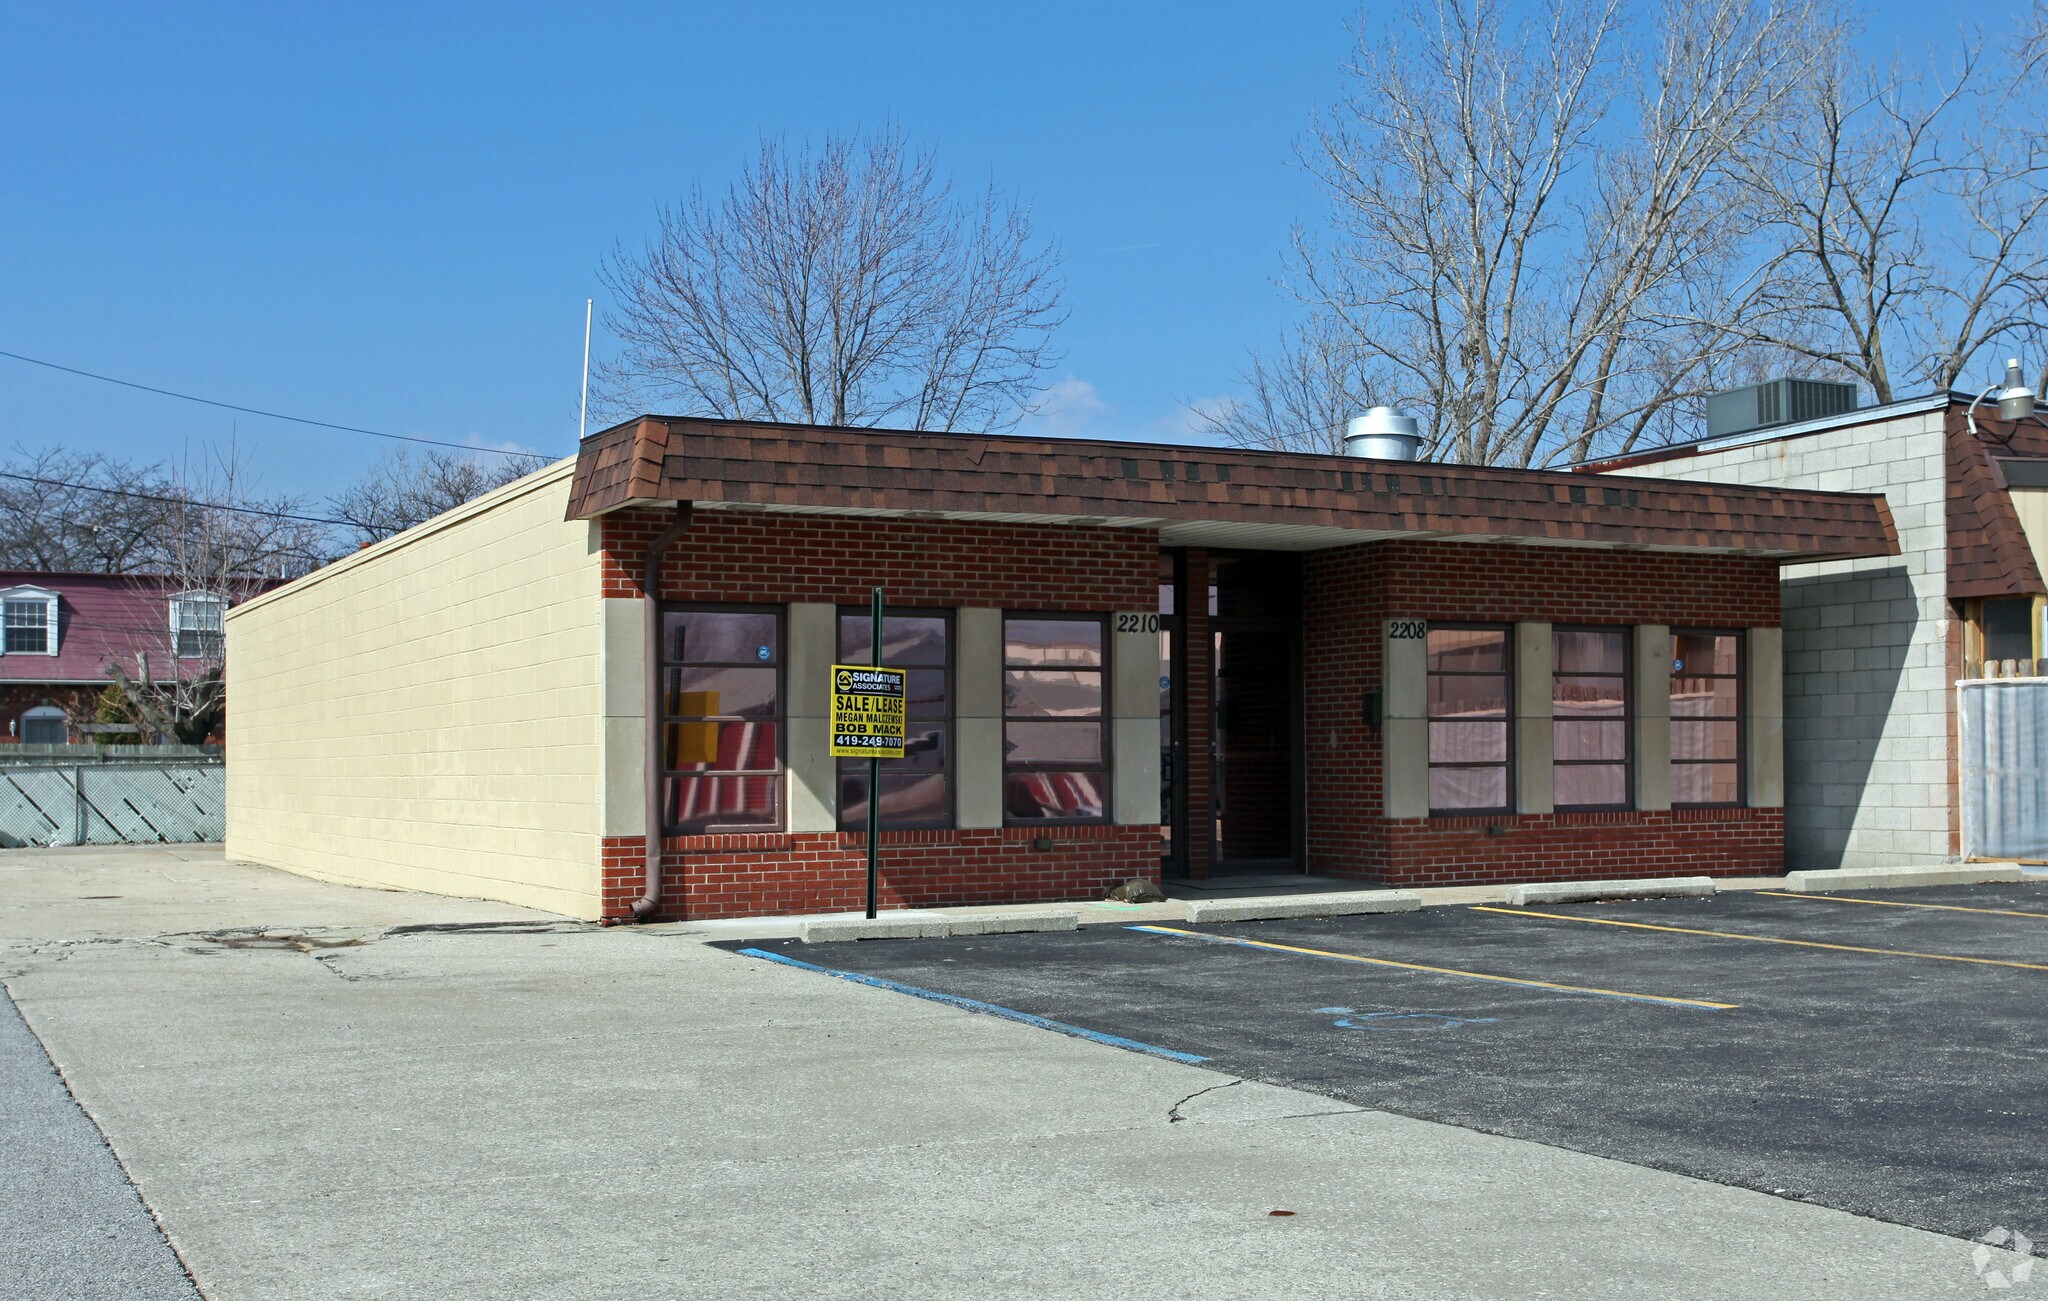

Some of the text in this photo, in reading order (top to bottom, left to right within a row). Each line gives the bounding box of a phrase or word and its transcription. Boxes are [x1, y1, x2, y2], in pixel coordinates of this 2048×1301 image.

[1117, 614, 1159, 633] 2210
[1389, 621, 1425, 639] 2208
[852, 672, 901, 684] SIGNATURE
[852, 683, 891, 691] ASSOCIATES
[836, 712, 864, 722] MEGAN
[836, 723, 902, 735] BOB MACK
[836, 735, 902, 747] 419-249-7070
